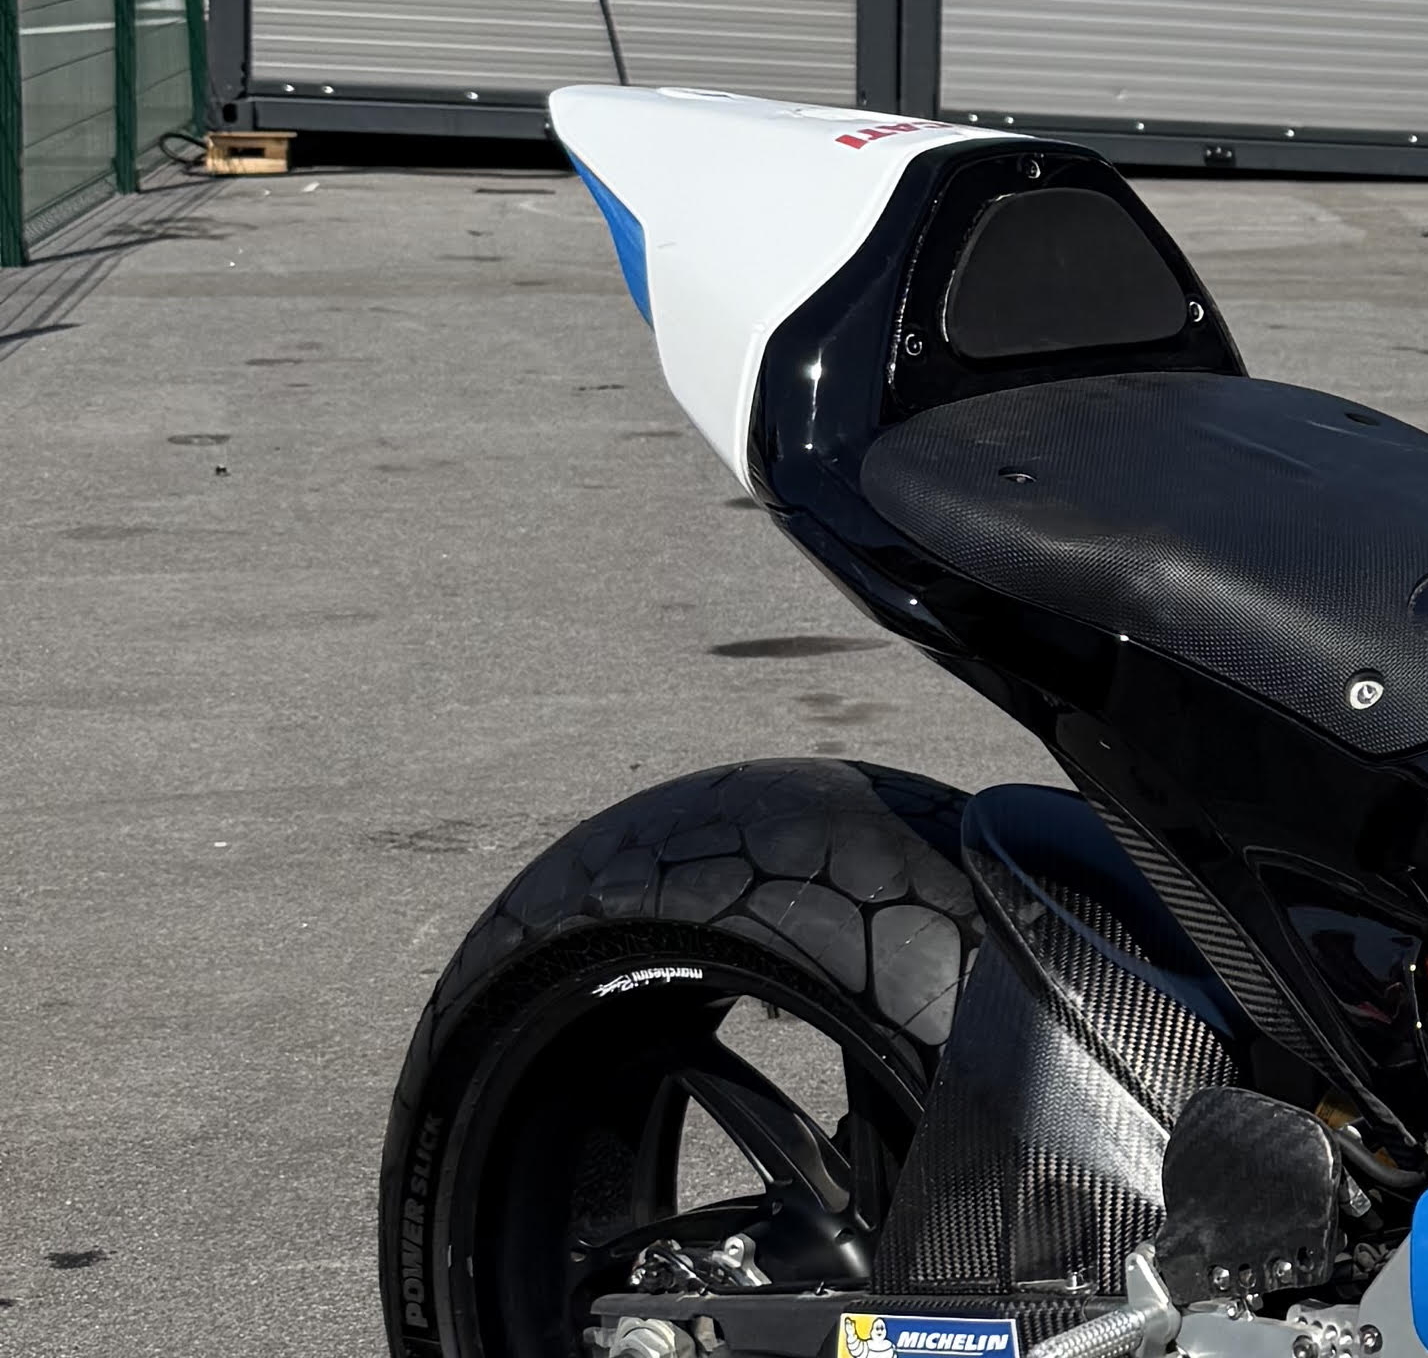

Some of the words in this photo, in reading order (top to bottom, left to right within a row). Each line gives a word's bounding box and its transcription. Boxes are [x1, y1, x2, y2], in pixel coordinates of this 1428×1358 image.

[834, 121, 953, 150] CATI
[409, 1110, 446, 1196] SLICK
[404, 1198, 429, 1331] POWER
[896, 1330, 1010, 1352] MICHELIN
